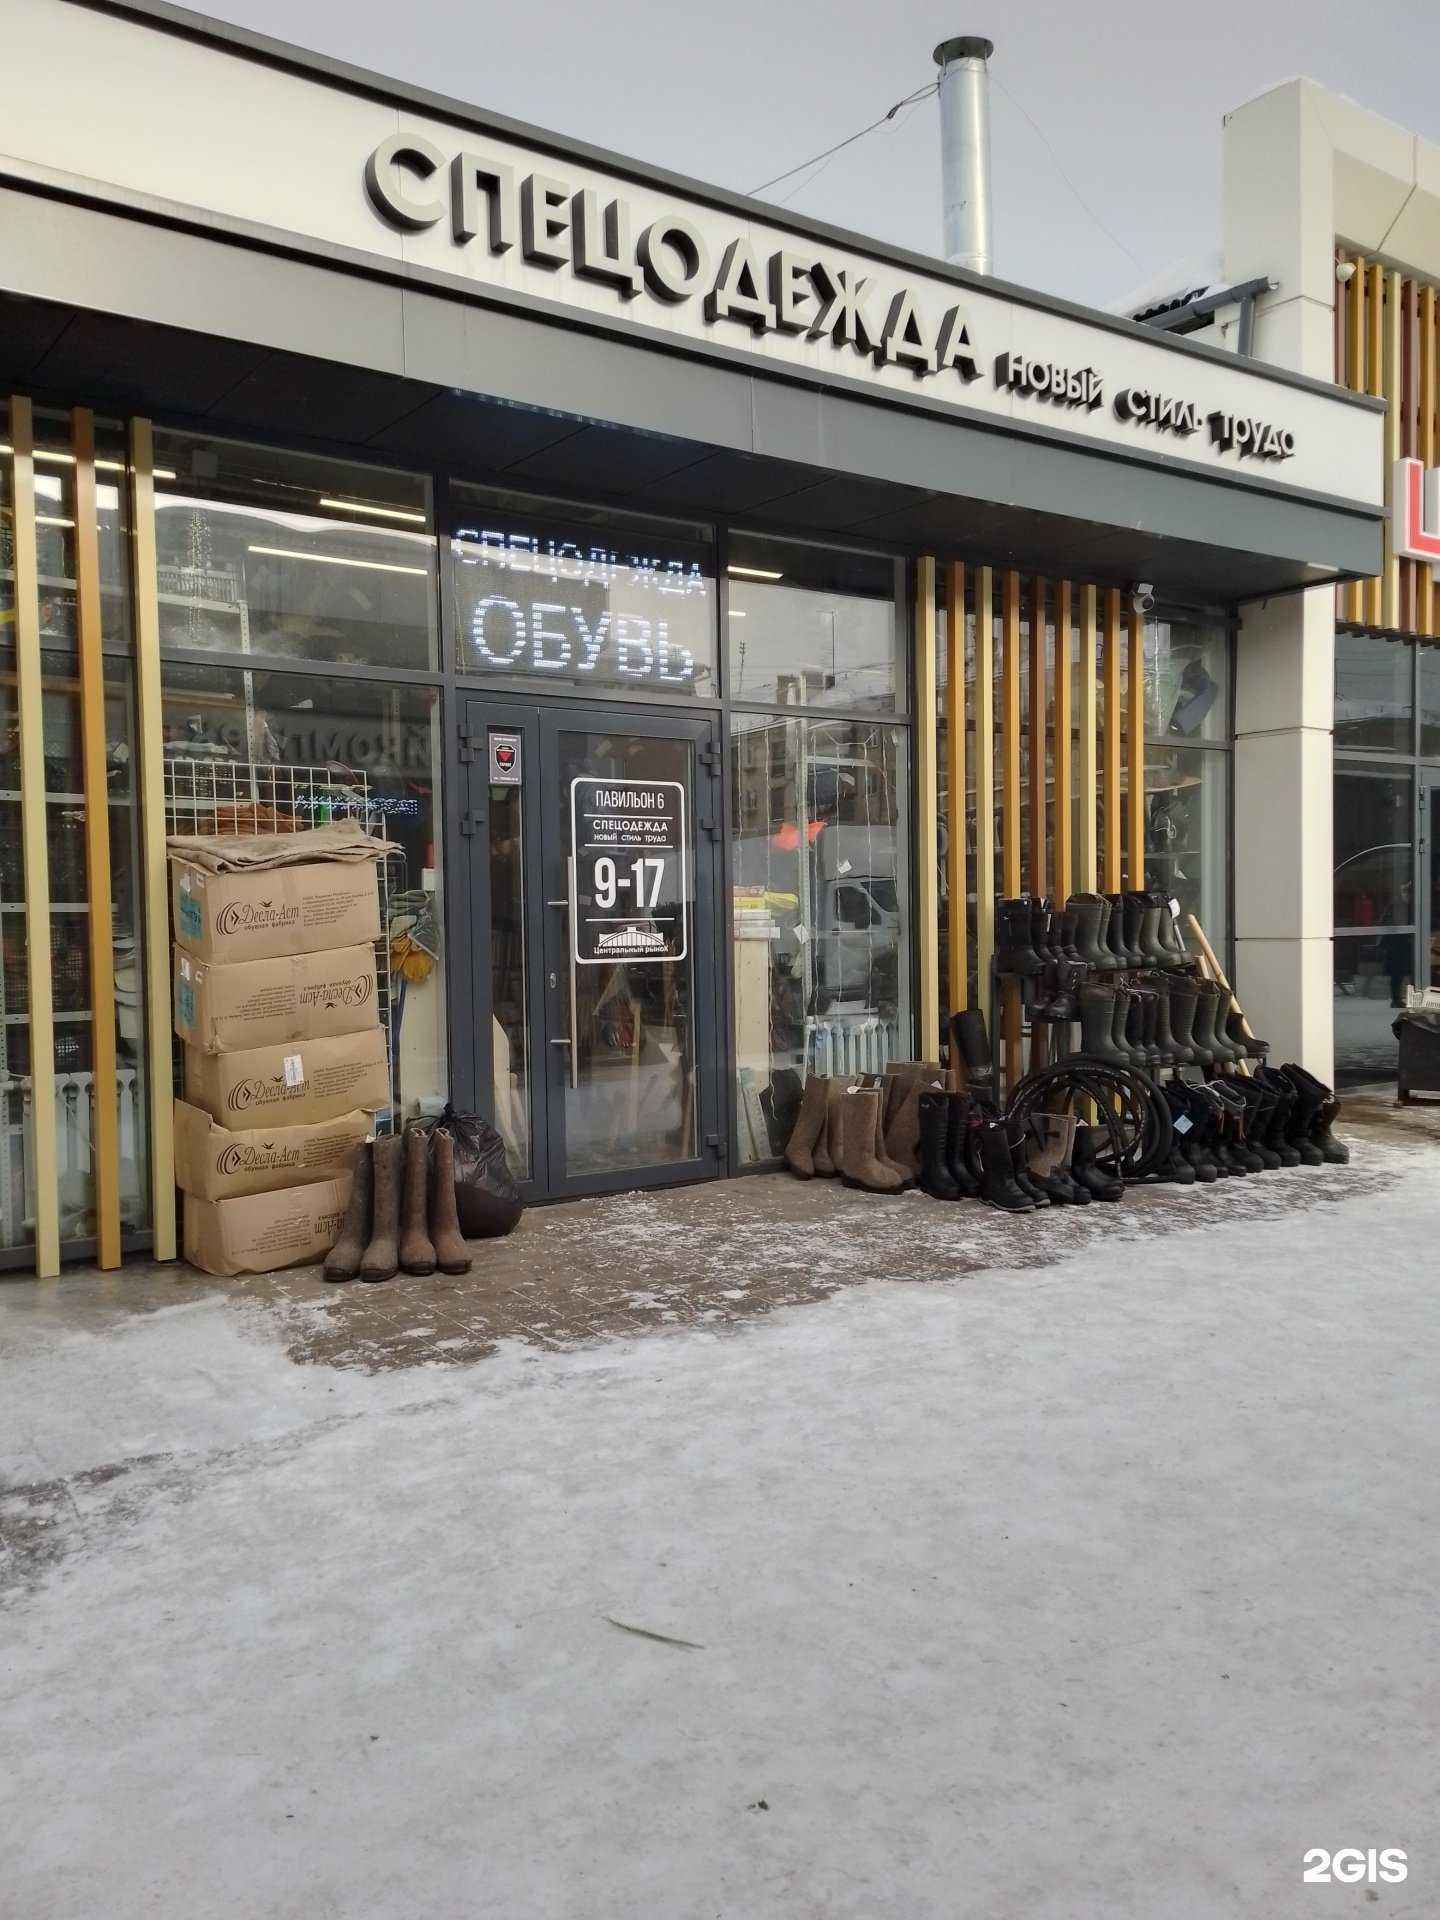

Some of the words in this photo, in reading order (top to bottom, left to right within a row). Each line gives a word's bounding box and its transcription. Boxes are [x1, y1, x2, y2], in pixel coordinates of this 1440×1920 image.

[365, 131, 985, 382] СПЕЦОДЕЖДА
[472, 593, 695, 681] ОБУВЬ
[596, 790, 655, 809] ПАВИЛЬОН
[657, 793, 665, 809] 6
[593, 819, 668, 832] СПЕЦОДЕЖДА
[594, 857, 665, 909] 9-17
[594, 946, 644, 955] Центральный
[645, 944, 668, 955] рынок
